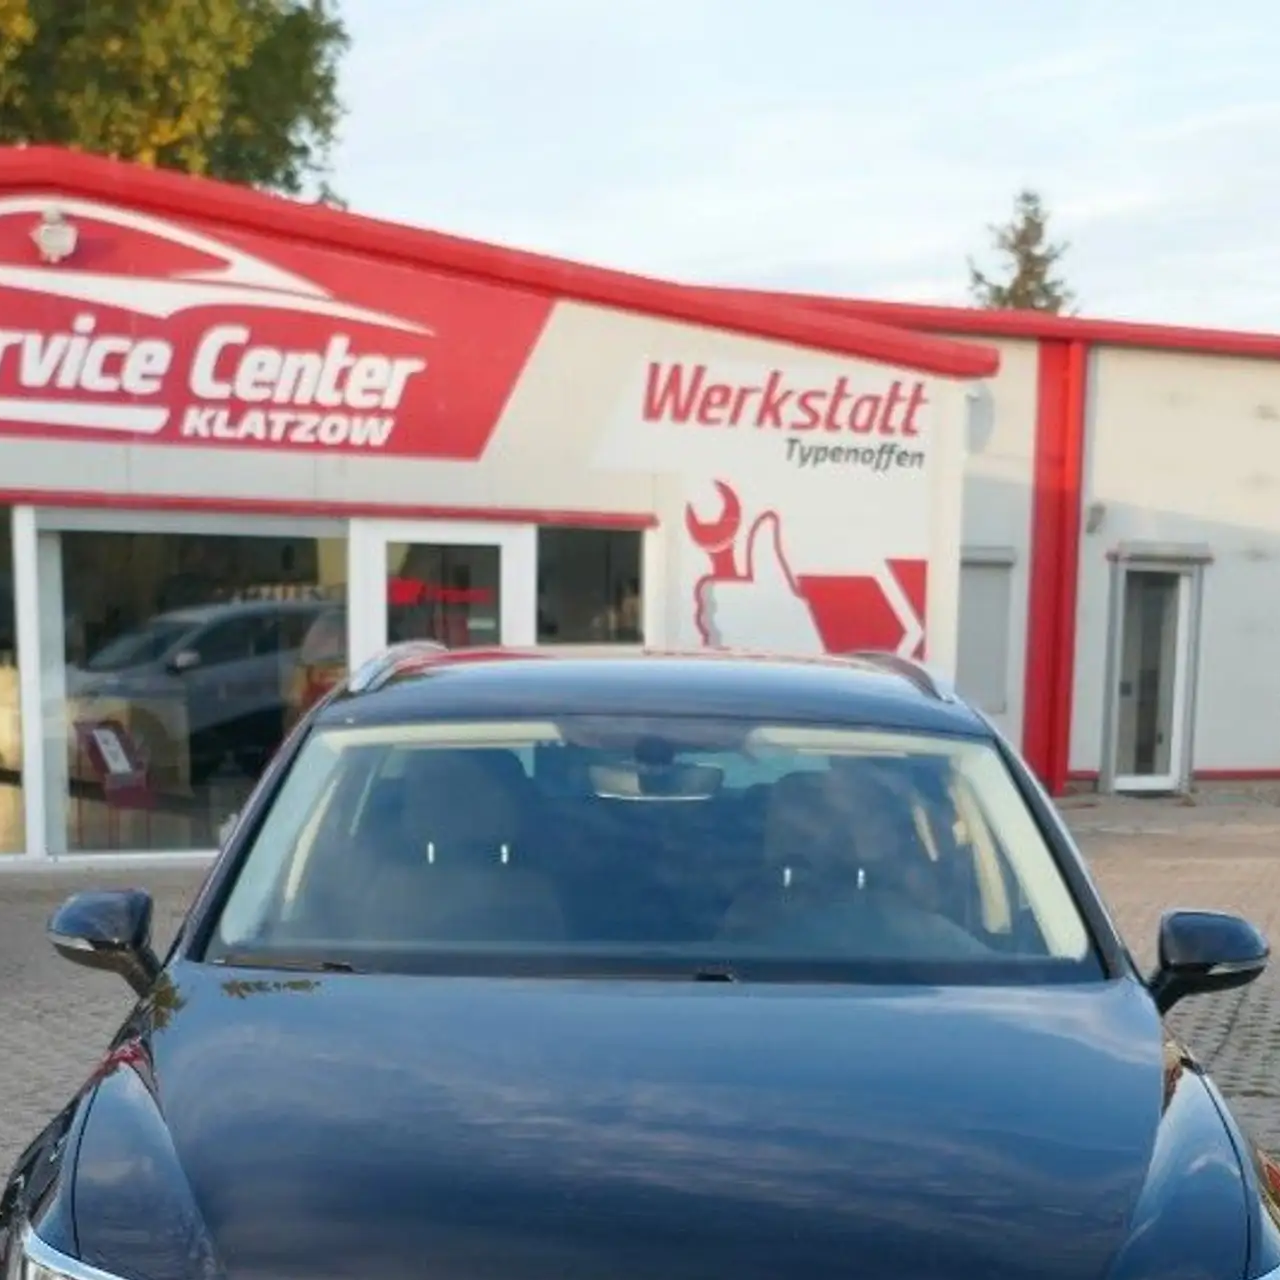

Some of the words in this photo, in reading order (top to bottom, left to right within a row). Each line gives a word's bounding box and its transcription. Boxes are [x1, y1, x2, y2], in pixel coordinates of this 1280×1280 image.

[189, 325, 426, 411] Center
[182, 406, 394, 447] KLATZOW
[642, 361, 930, 437] Werkstatt
[785, 438, 926, 472] Typenoffen
